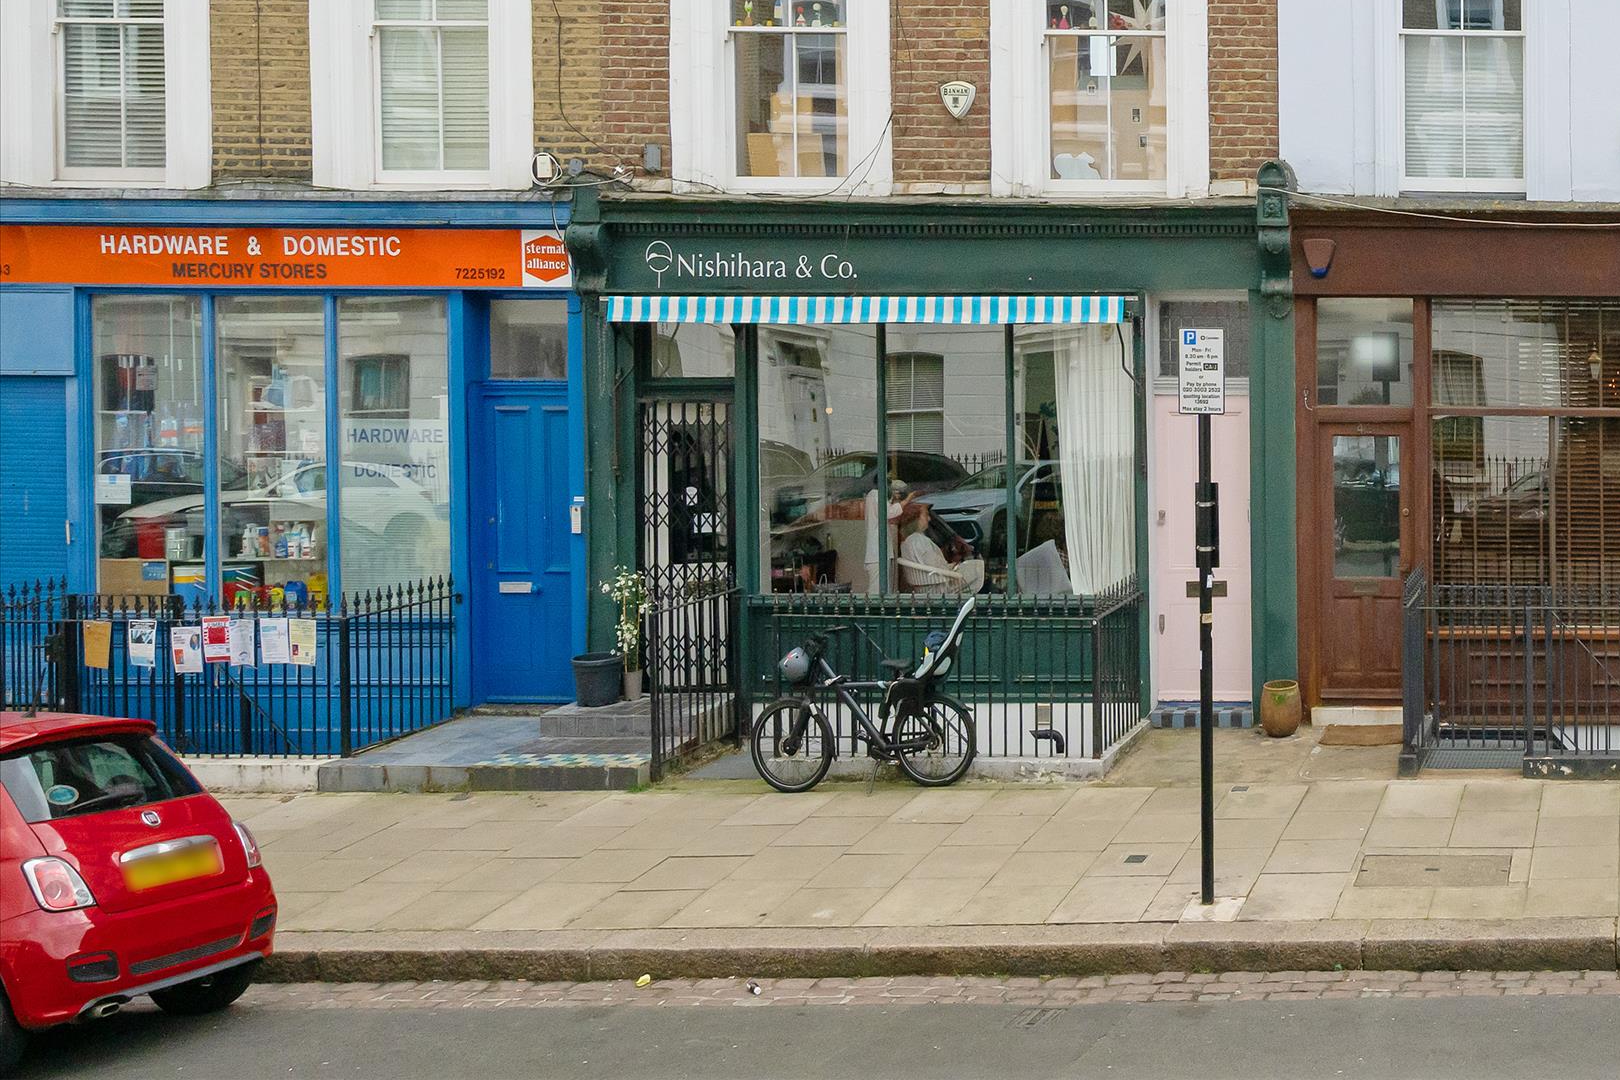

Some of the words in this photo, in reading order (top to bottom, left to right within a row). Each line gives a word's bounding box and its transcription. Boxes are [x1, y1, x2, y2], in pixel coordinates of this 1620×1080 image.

[100, 235, 229, 255] HARDWARE
[246, 236, 262, 256] &
[283, 236, 401, 256] DOMESTIC
[526, 243, 566, 254] stermat
[172, 263, 254, 279] MERCURY
[259, 263, 327, 279] STORES
[526, 258, 566, 270] alliance
[677, 252, 787, 277] Nishihara
[795, 255, 813, 278] &
[820, 254, 858, 278] Co.
[455, 268, 505, 280] 7225192
[346, 428, 444, 443] HARDWARE
[354, 463, 436, 478] DOMESTIC
